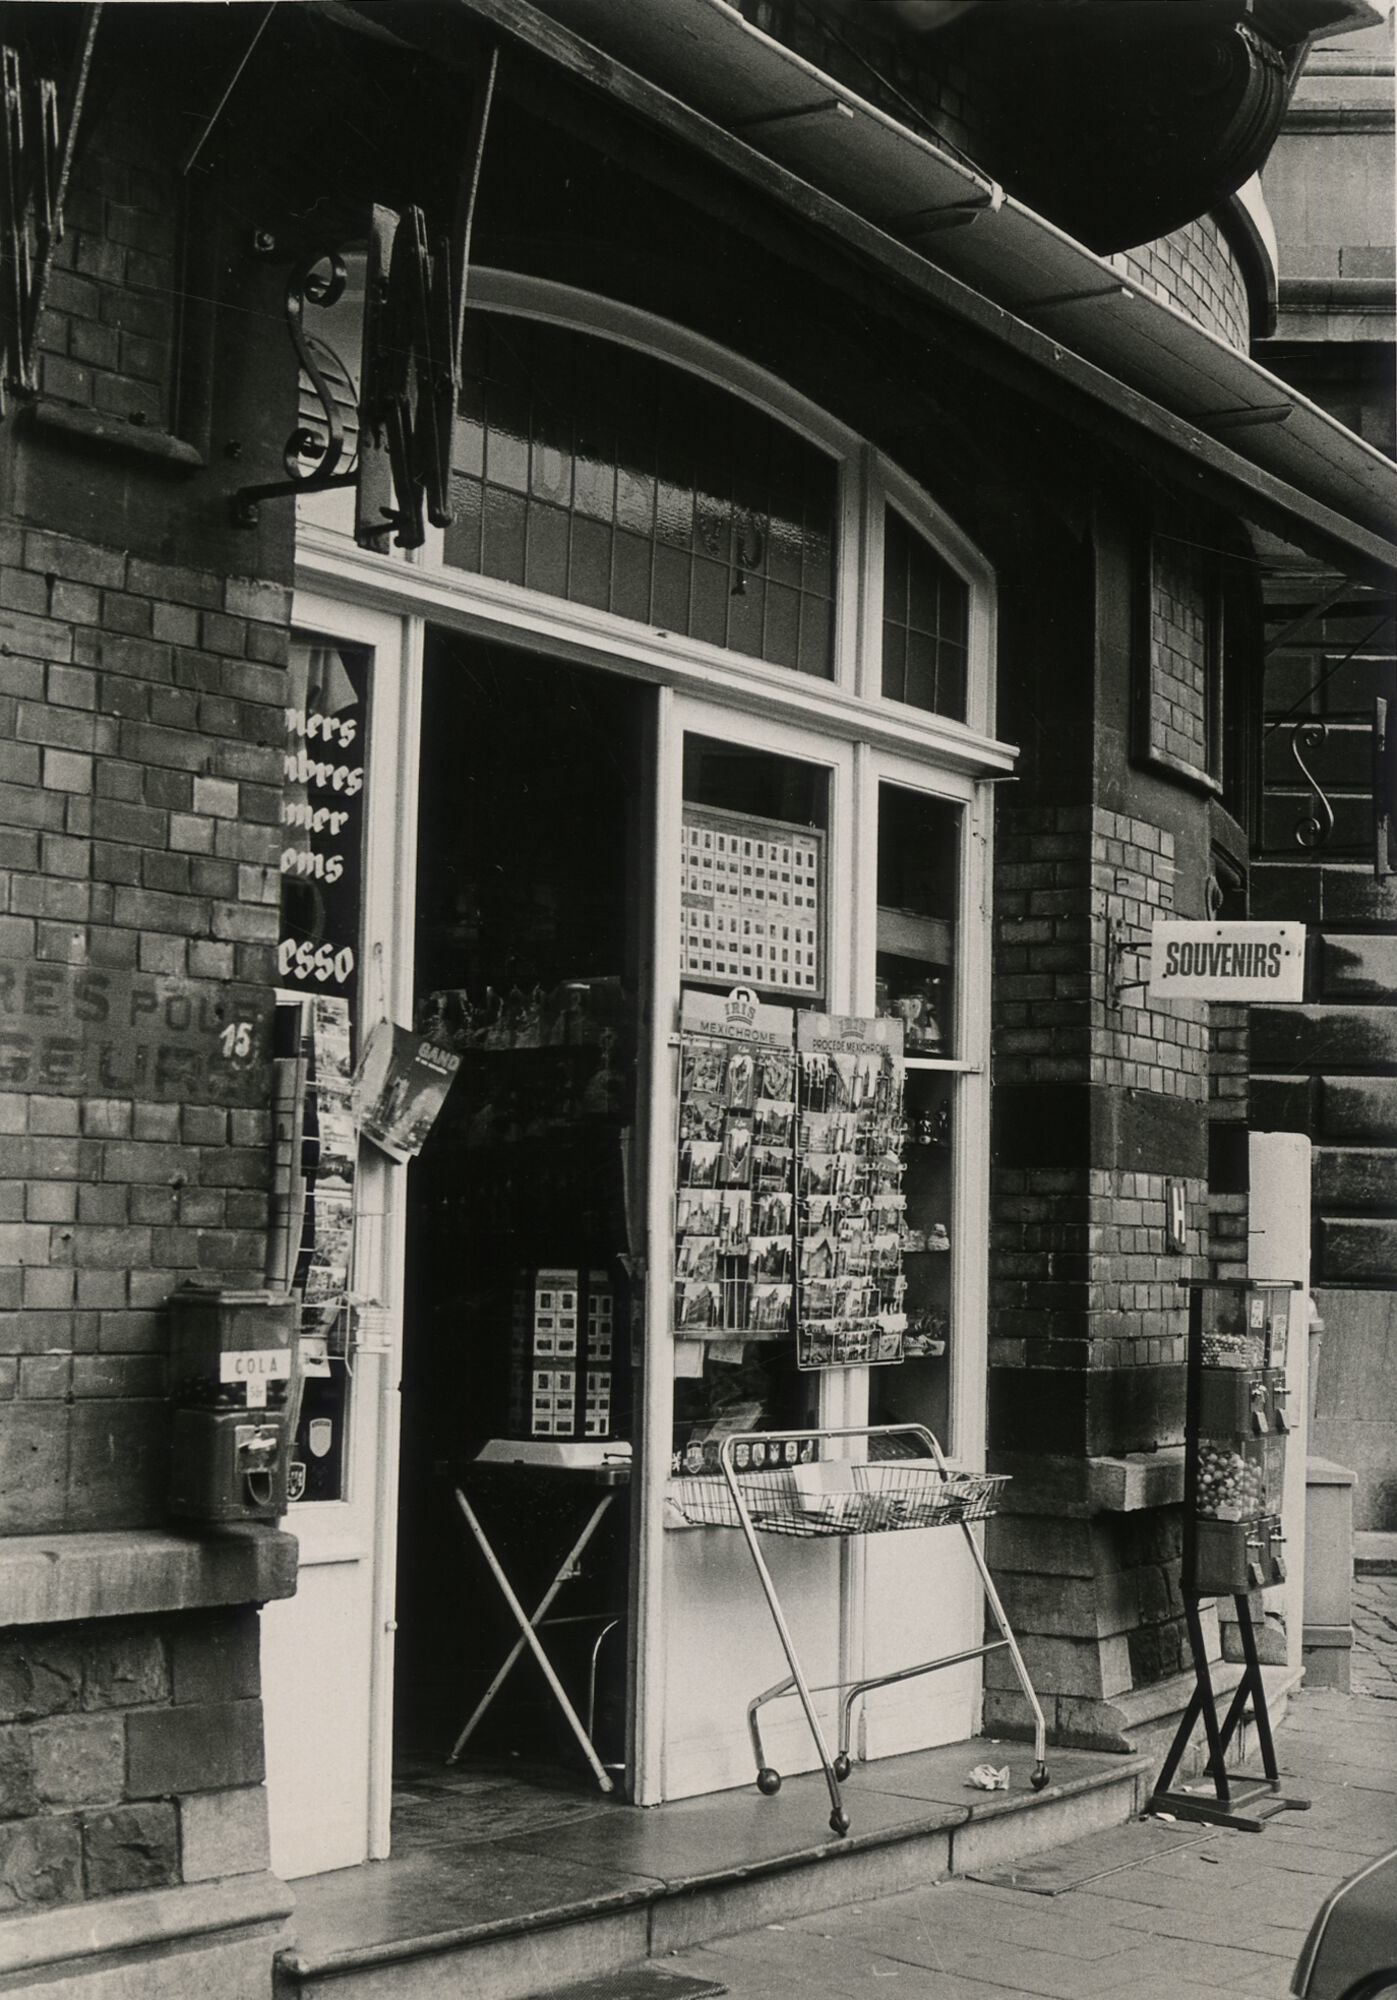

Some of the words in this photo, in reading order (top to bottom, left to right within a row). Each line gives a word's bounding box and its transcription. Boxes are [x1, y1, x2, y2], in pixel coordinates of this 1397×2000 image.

[1166, 942, 1282, 977] SOUVENIRS
[725, 1002, 757, 1020] IRIS
[219, 1022, 254, 1058] 15
[700, 1021, 777, 1044] MEXICHROME
[1173, 1186, 1186, 1244] H
[235, 1357, 278, 1375] COLA
